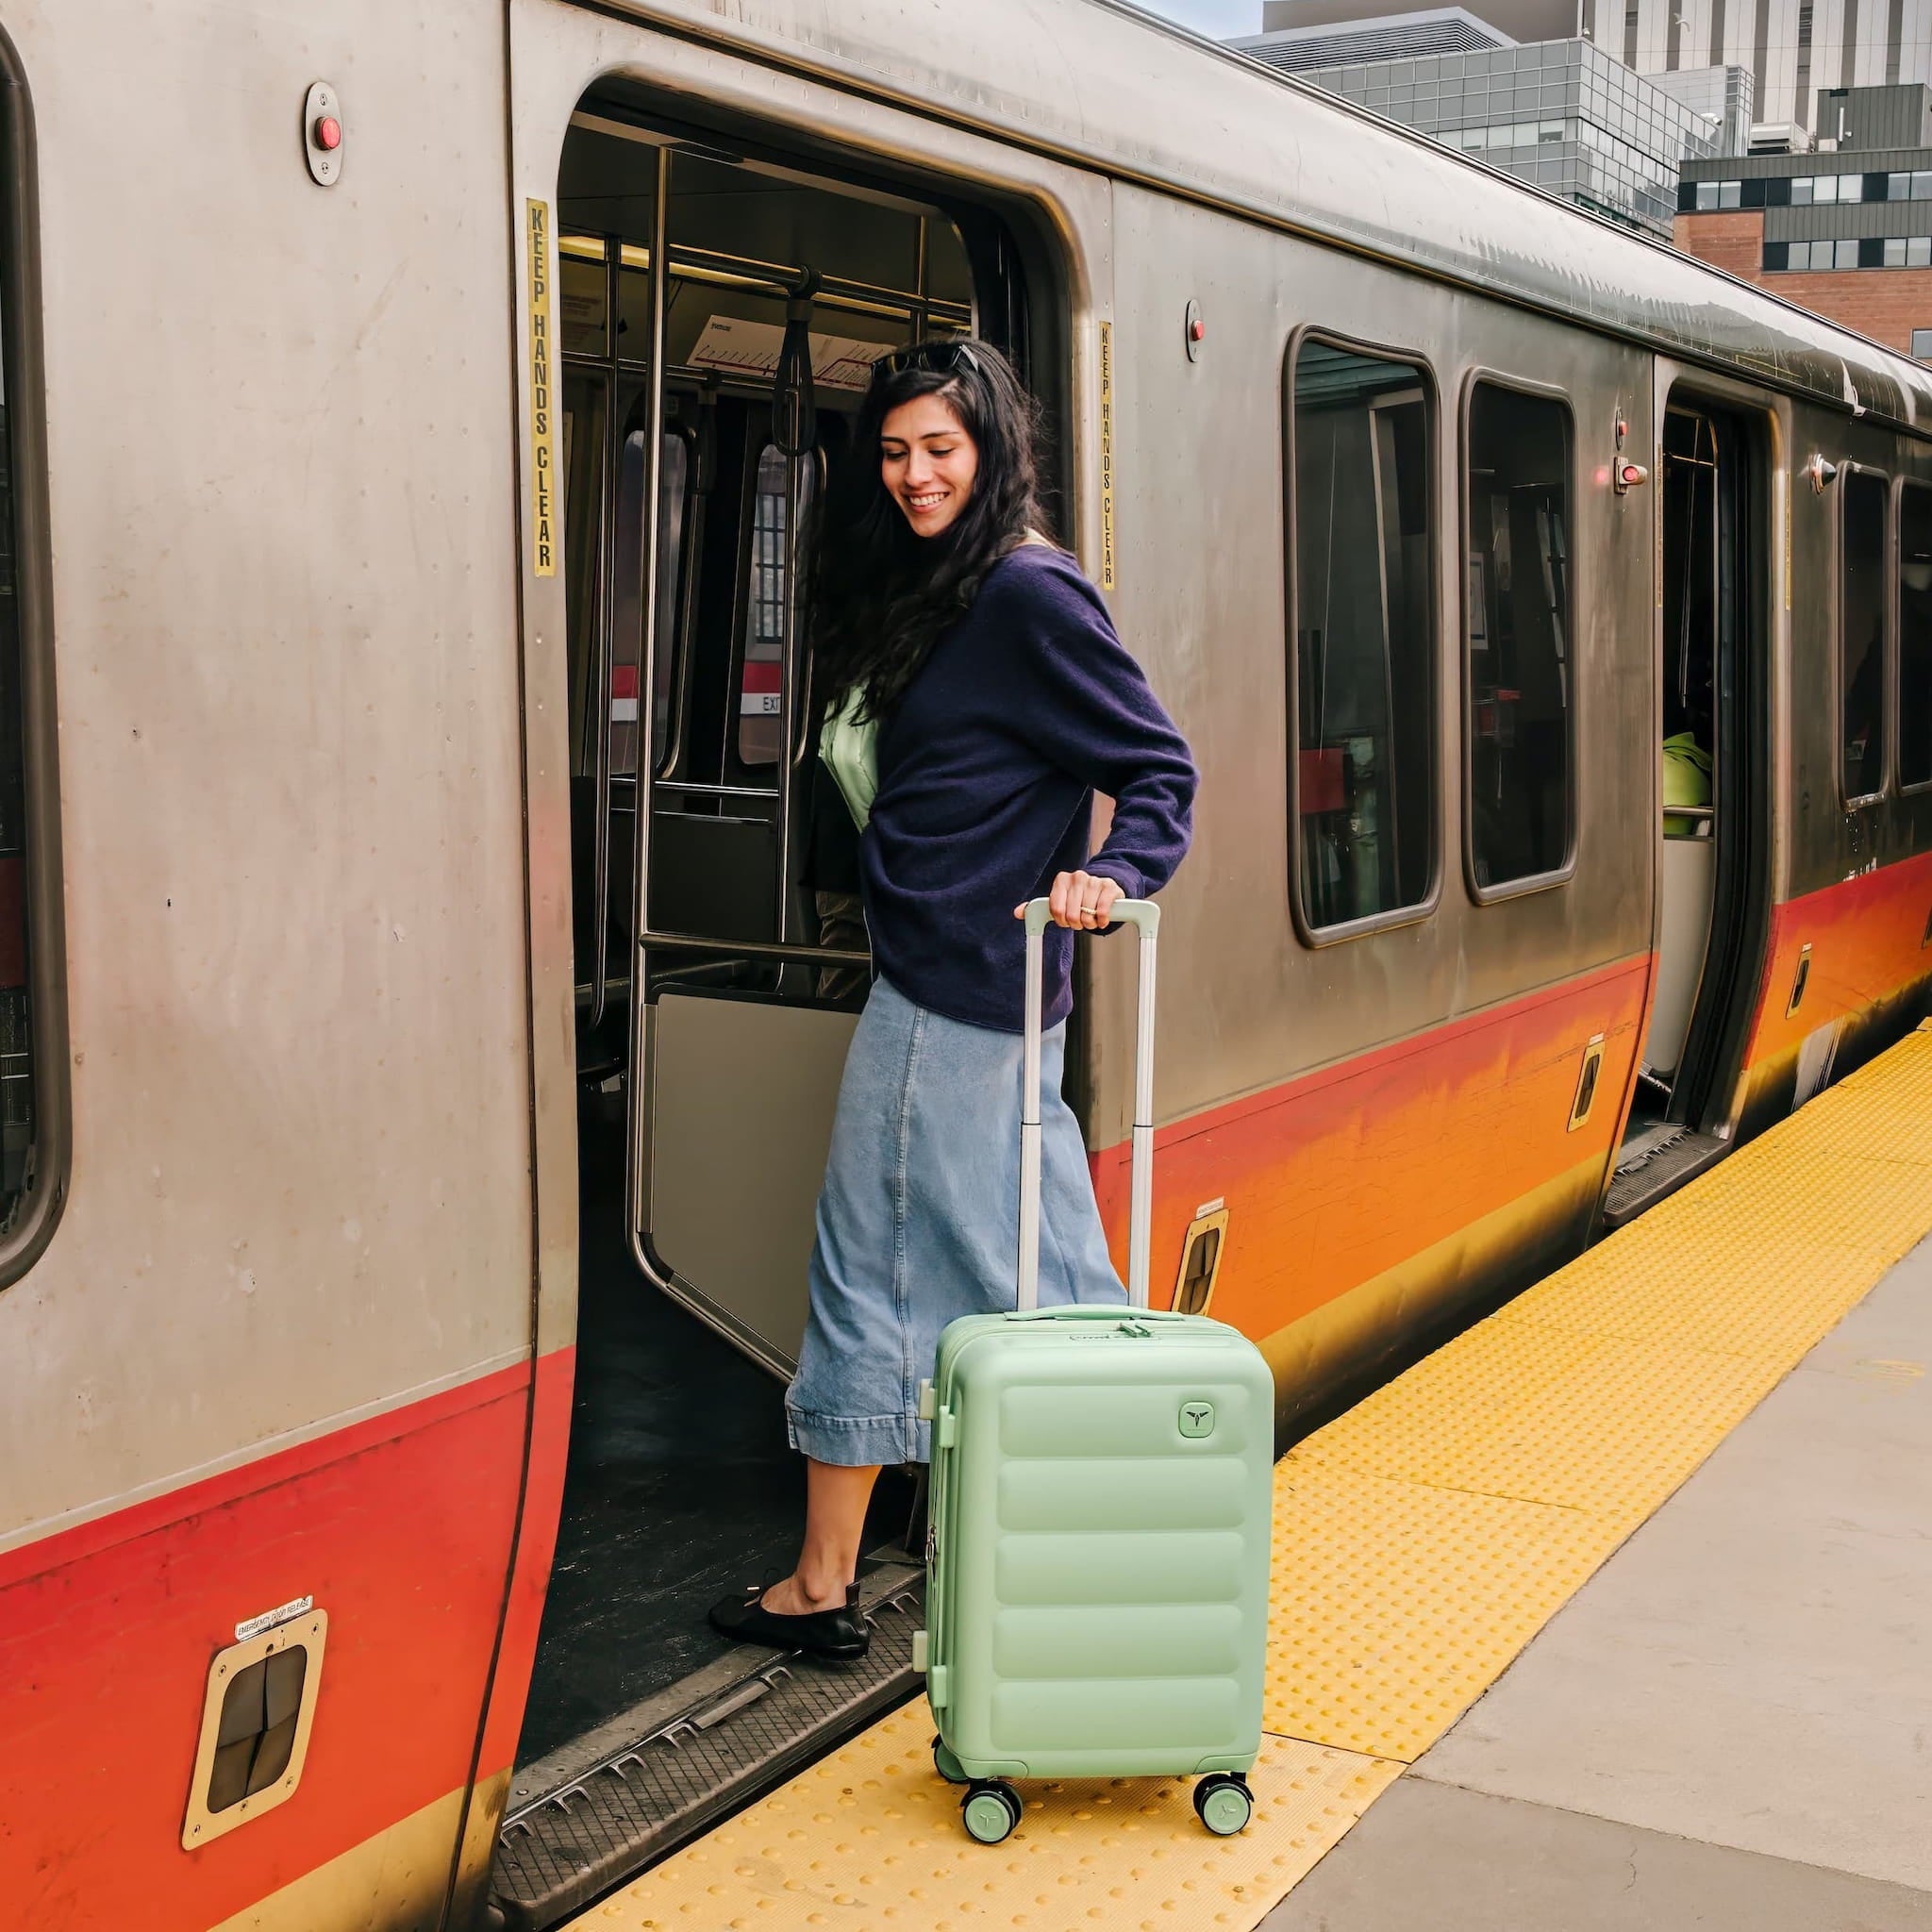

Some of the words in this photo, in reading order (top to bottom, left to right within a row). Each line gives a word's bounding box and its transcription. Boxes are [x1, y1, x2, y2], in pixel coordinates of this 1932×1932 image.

[531, 208, 545, 303] KEEP
[534, 314, 547, 436] HANDS
[536, 445, 551, 567] CLEAR
[1104, 497, 1112, 584] CLEAR
[287, 1598, 309, 1614] RELEASE
